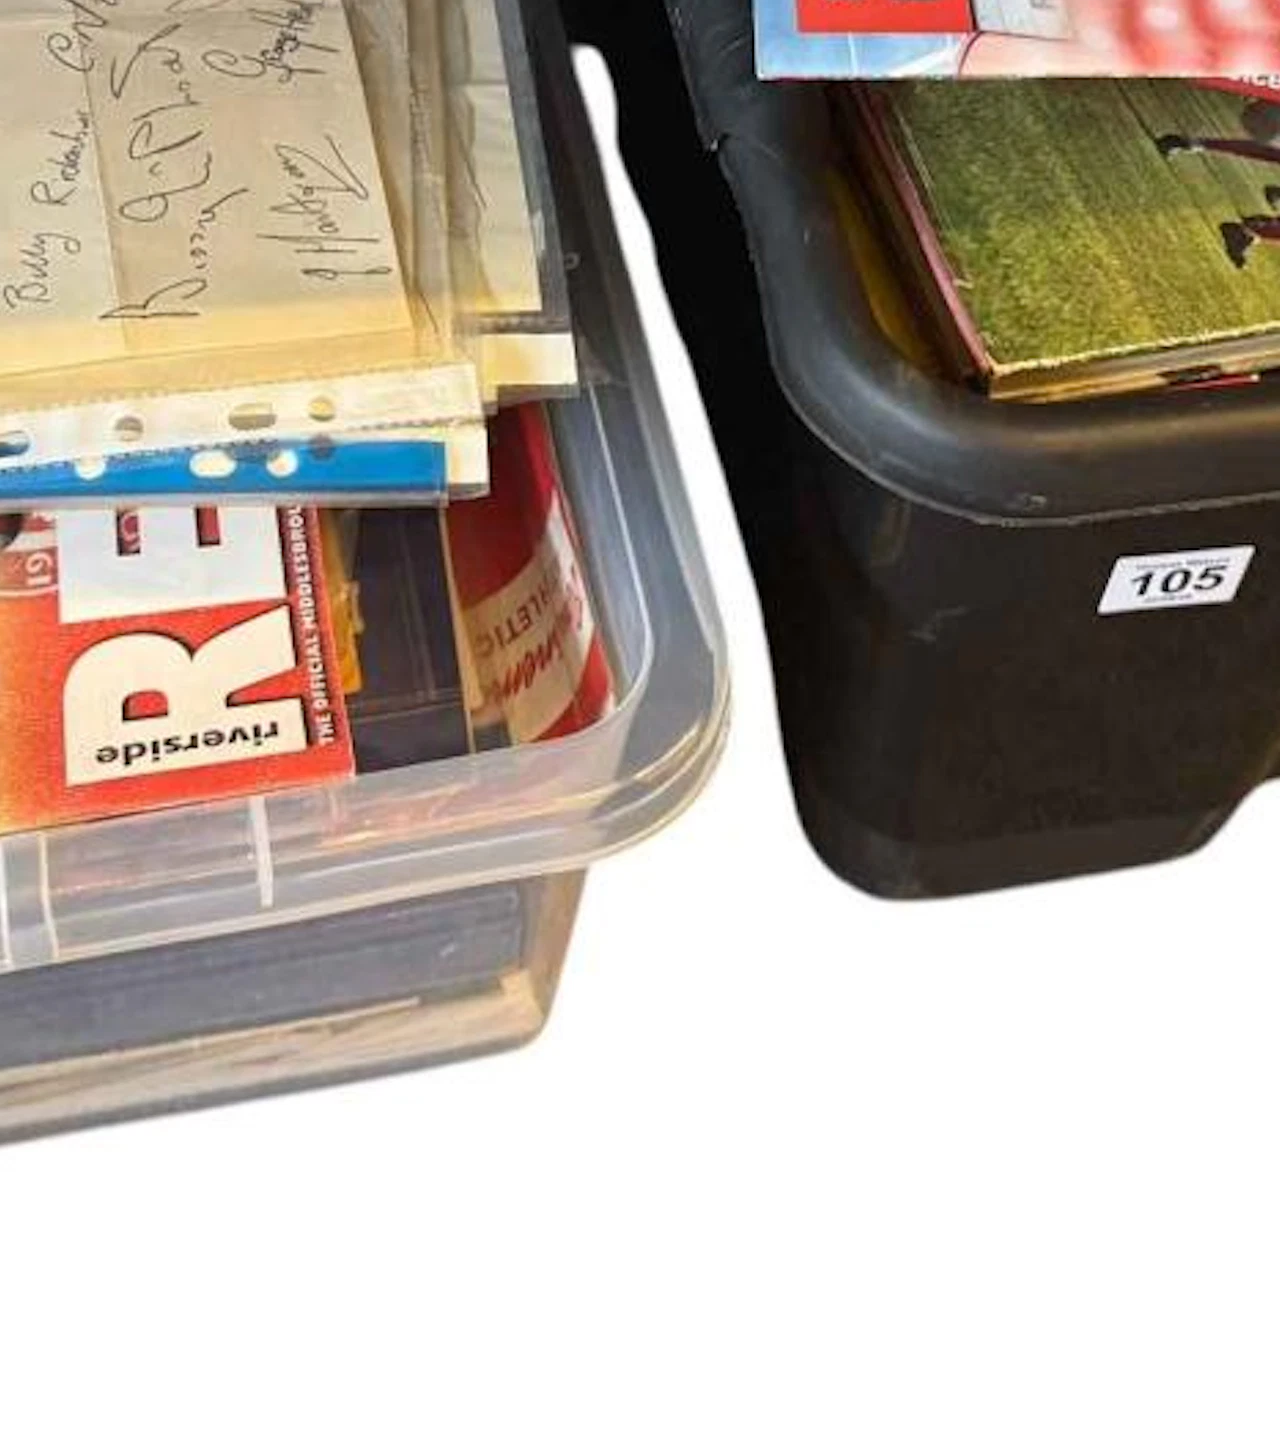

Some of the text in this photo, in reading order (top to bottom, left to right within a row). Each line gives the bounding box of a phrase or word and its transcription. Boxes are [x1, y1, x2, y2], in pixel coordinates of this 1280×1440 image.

[57, 506, 308, 788] RE
[291, 503, 332, 746] THE OFFICIAL MIDDLESBRO
[1131, 566, 1227, 595] 105
[96, 721, 279, 764] riverside
